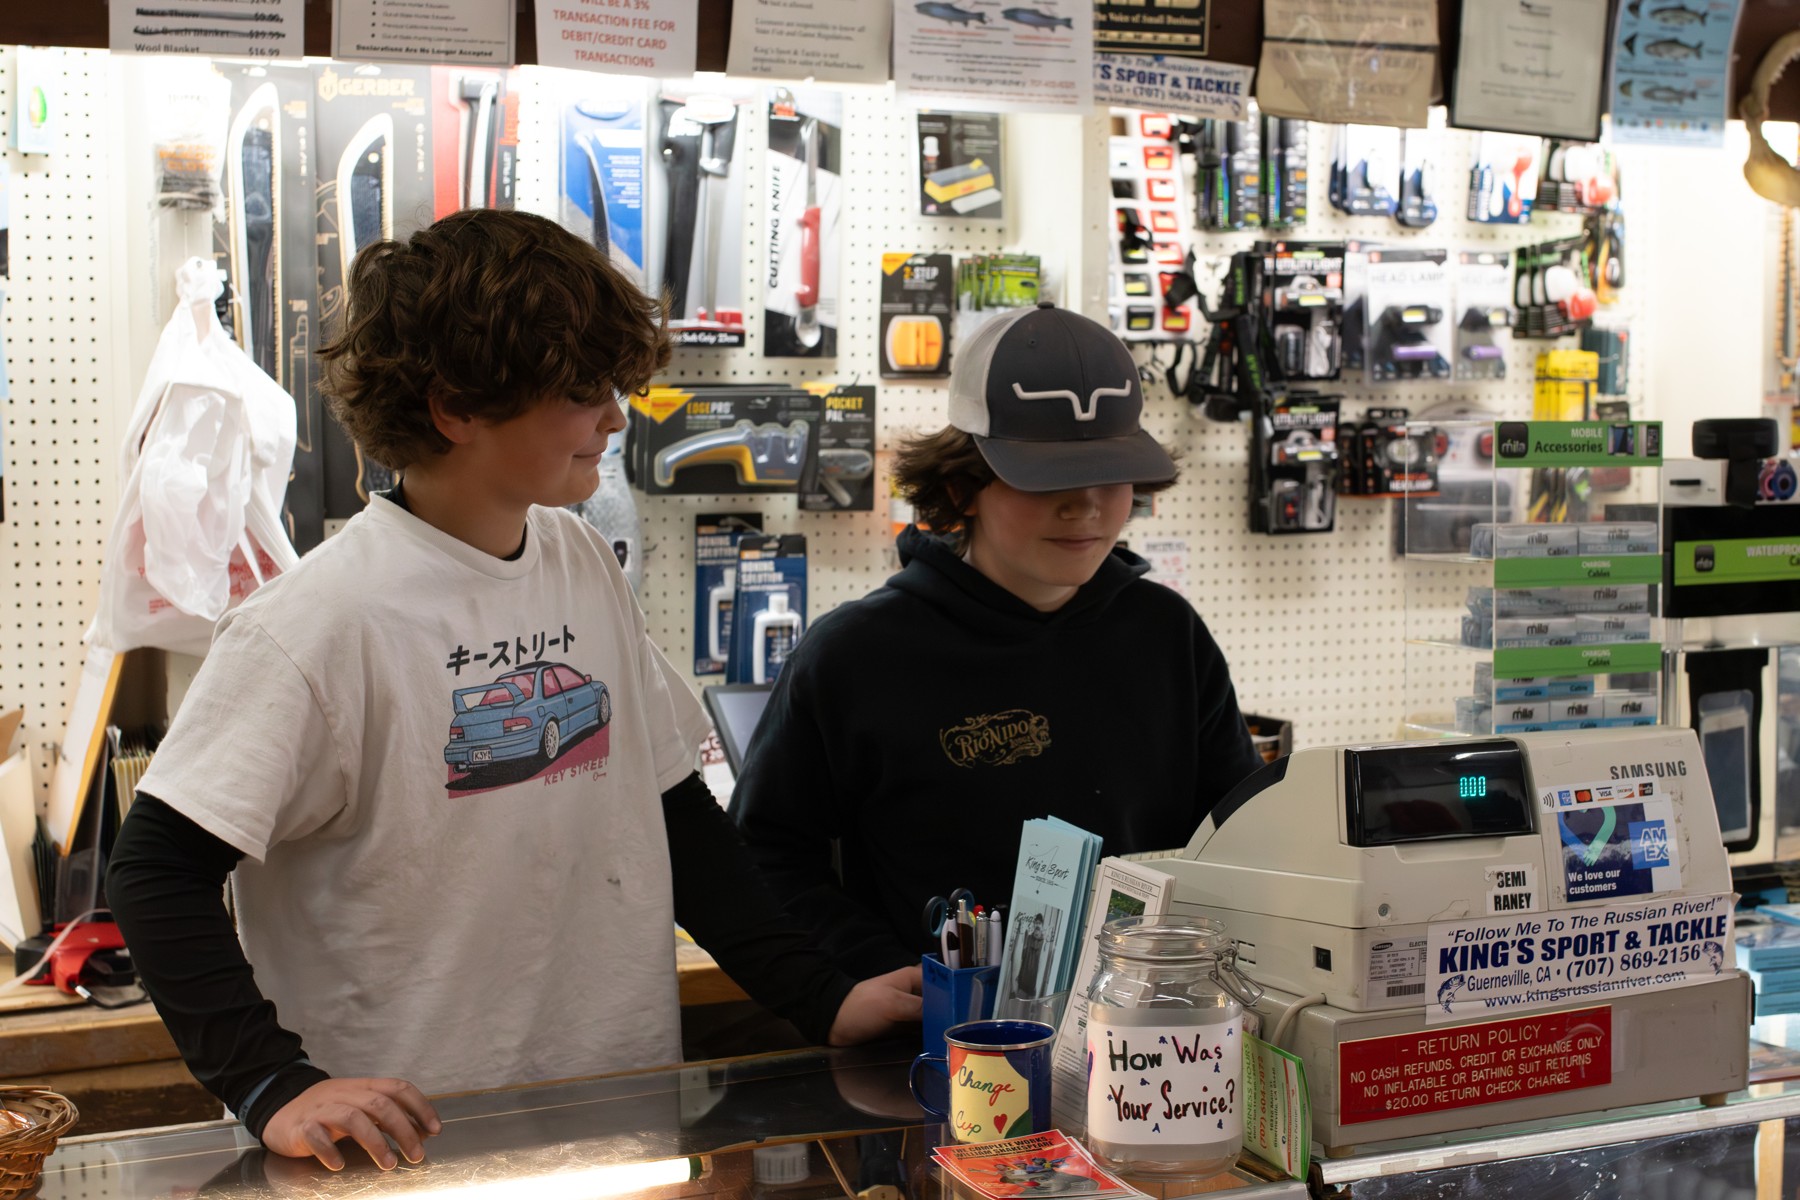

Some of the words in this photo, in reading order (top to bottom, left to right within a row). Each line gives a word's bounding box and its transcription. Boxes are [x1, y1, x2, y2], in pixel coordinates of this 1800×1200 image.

[553, 9, 629, 28] TRANSACTION
[632, 18, 651, 29] FEE
[653, 20, 675, 32] FOR
[135, 43, 161, 52] Wool
[163, 44, 199, 54] Blanket
[249, 47, 280, 57] $16.99
[562, 29, 634, 47] DEBIT/CREDIT
[637, 38, 667, 50] CARD
[575, 50, 655, 68] TRANSACTIONS
[339, 78, 415, 96] GERBER
[1116, 67, 1167, 86] SPORT
[1171, 76, 1181, 88] &
[1186, 76, 1241, 95] TACKLE
[772, 164, 780, 212] KNIFE
[769, 217, 779, 288] CUTTING
[825, 397, 863, 411] POCKET
[1571, 427, 1603, 439] MOBILE
[1501, 438, 1526, 454] mila
[1534, 441, 1603, 454] Accessories
[1582, 560, 1611, 568] CHARGING
[1588, 569, 1610, 578] Cables
[1527, 622, 1548, 635] mila
[446, 625, 575, 676] キーストリート
[1582, 650, 1611, 658] CHARGING
[1588, 658, 1610, 667] Cables
[1512, 707, 1535, 720] mila
[1567, 703, 1588, 716] mila
[1621, 702, 1643, 715] mila
[544, 770, 566, 786] KEY
[570, 756, 608, 778] STREET
[1610, 759, 1688, 781] SAMSUNG
[1599, 790, 1613, 798] VISA
[1025, 856, 1047, 874] King's
[1048, 863, 1070, 880] Sport
[1568, 872, 1583, 882] We
[1585, 871, 1603, 881] love
[1606, 869, 1621, 878] our
[1569, 882, 1617, 895] customers
[1494, 893, 1532, 911] RANEY
[1448, 927, 1511, 944] "Follow
[1515, 922, 1541, 936] Me
[1547, 919, 1565, 932] To
[1570, 915, 1599, 929] The
[1604, 907, 1667, 925] Russian
[1672, 896, 1723, 917] River!"
[1439, 937, 1535, 974] KING'S
[1540, 930, 1620, 961] SPORT
[1624, 931, 1642, 950] &
[1647, 914, 1727, 947] TACKLE
[1467, 969, 1533, 991] Guerneville,
[1536, 966, 1551, 983] CA
[1567, 956, 1615, 982] (707)
[1620, 943, 1700, 971] 869-2156
[1484, 970, 1687, 1007] www.kingsrussianriver.com
[1418, 1033, 1480, 1055] RETURN
[1488, 1024, 1541, 1046] POLICY
[1109, 1039, 1162, 1072] How
[1171, 1033, 1223, 1064] Was
[1350, 1070, 1366, 1084] NO
[1371, 1066, 1399, 1081] CASH
[1404, 1058, 1455, 1076] REFUNDS.
[1460, 1052, 1496, 1068] CREDIT
[1501, 1049, 1516, 1062] OR
[1520, 1040, 1573, 1059] EXCHANGE
[1577, 1036, 1602, 1050] ONLY
[958, 1065, 1016, 1106] Change
[1363, 1085, 1379, 1098] NO
[1384, 1075, 1447, 1095] INFLATABLE
[1452, 1072, 1467, 1085] OR
[1471, 1065, 1514, 1082] BATHING
[1518, 1061, 1541, 1075] SUIT
[1546, 1053, 1592, 1071] RETURNS
[1109, 1084, 1152, 1122] Your
[1160, 1078, 1236, 1120] Service?
[1385, 1093, 1429, 1110] $20.00
[1434, 1086, 1480, 1103] RETURN
[1486, 1079, 1522, 1096] CHECK
[1527, 1071, 1571, 1089] CHARGE
[956, 1110, 982, 1137] Cup
[954, 1149, 993, 1158] WILLIAM
[993, 1141, 1055, 1155] SHAKESPEARE
[969, 1141, 1012, 1153] COMPLETE
[1013, 1136, 1049, 1147] WORKS
